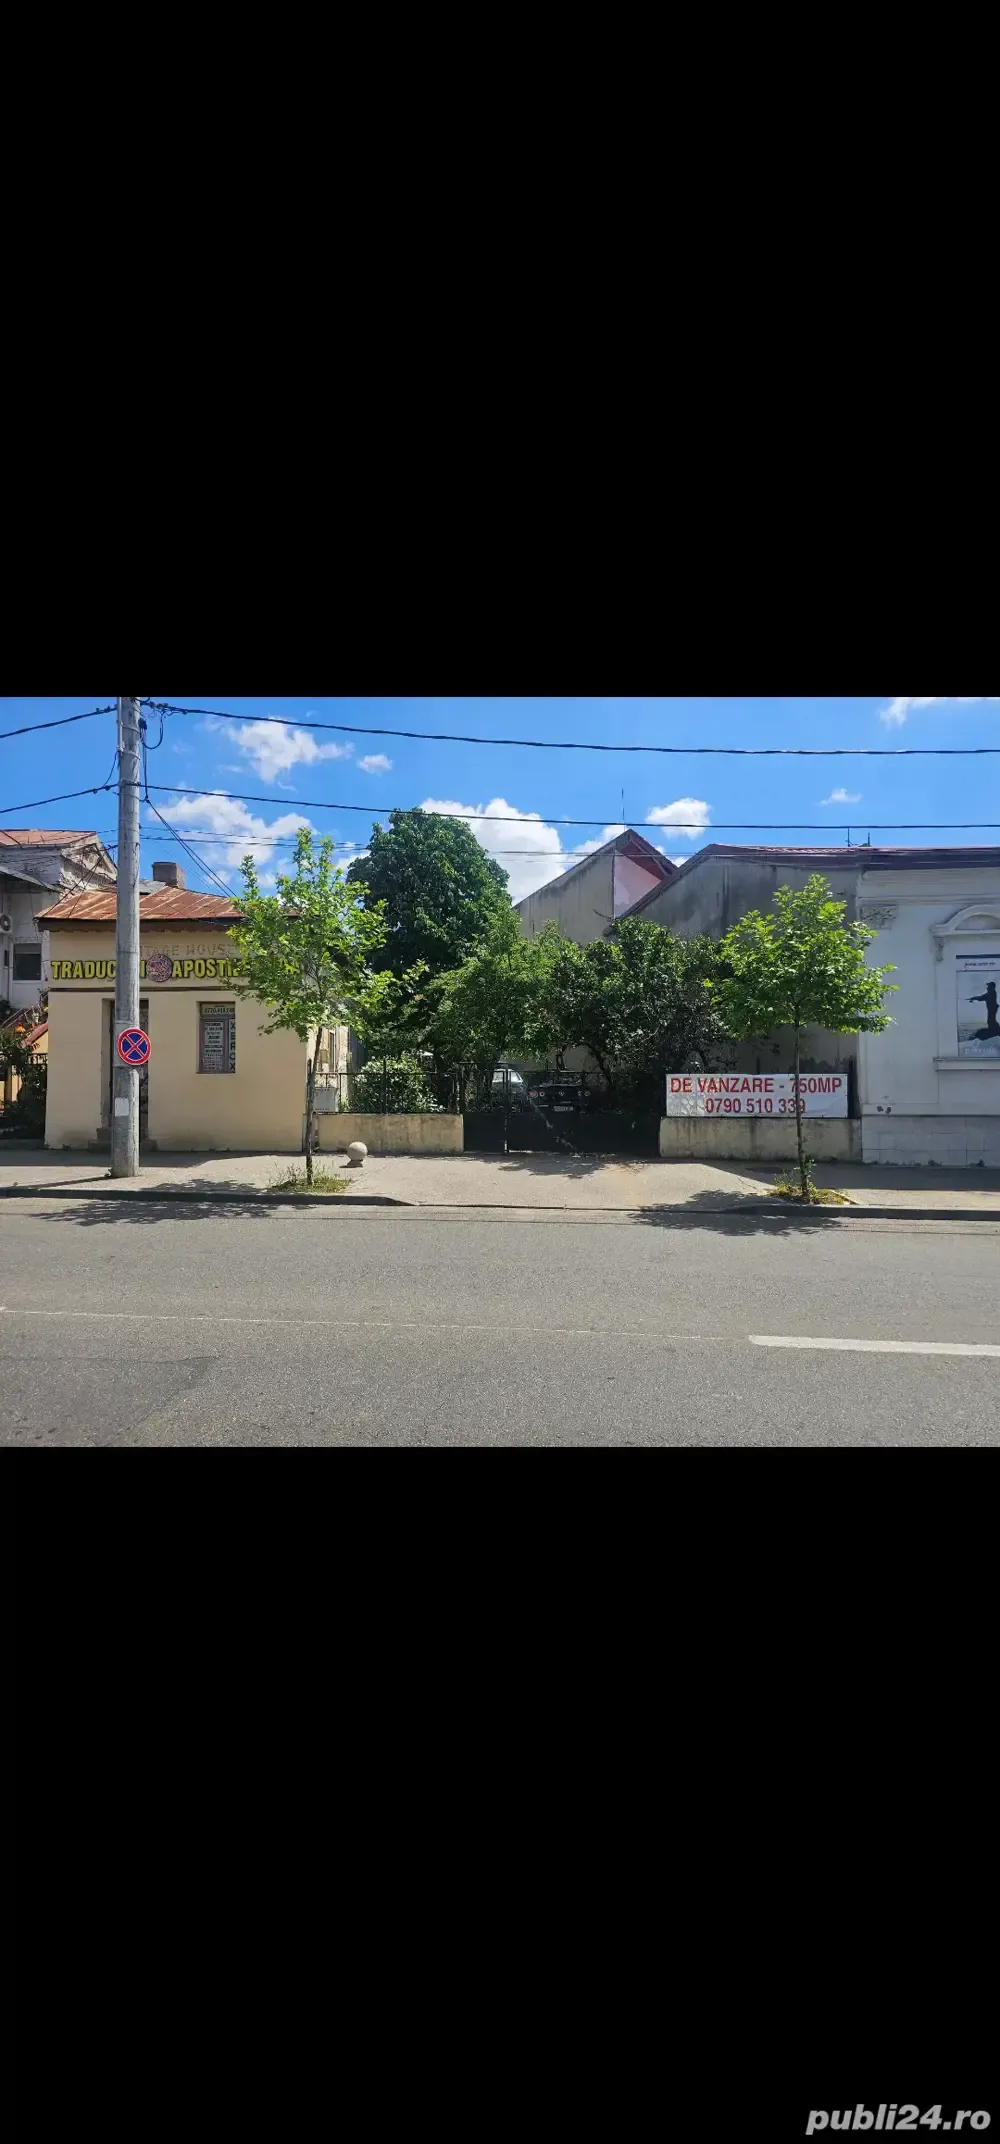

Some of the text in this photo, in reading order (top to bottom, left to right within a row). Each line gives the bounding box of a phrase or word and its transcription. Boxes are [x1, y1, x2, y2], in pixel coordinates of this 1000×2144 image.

[51, 960, 146, 979] TRADUCI
[670, 1078, 692, 1093] DE
[698, 1077, 774, 1092] VANZARE
[789, 1077, 842, 1093] 750MP
[705, 1098, 806, 1114] 0790 510 339
